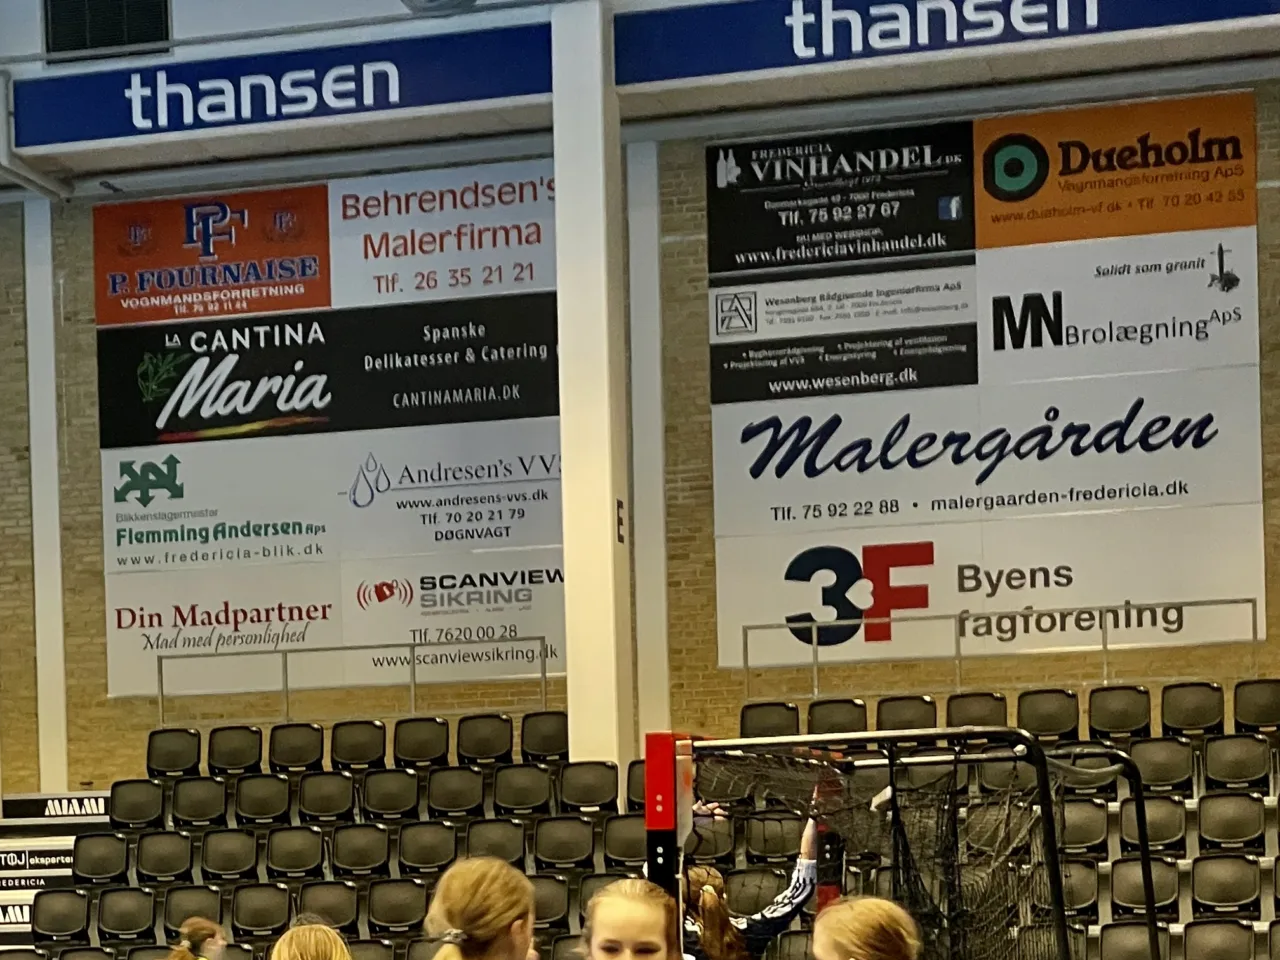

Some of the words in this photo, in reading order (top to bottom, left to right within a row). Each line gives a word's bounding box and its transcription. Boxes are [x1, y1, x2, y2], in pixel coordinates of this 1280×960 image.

[785, 0, 1099, 58] thansen
[124, 61, 400, 129] thansen
[751, 143, 833, 160] FREDERICIA
[1057, 127, 1244, 177] Dueholm
[363, 221, 543, 261] Malerfirma
[734, 232, 948, 265] www.fredericiavinhandel.dk
[136, 255, 320, 294] FOURNAISE
[373, 272, 404, 294] Tlf.
[414, 270, 438, 290] 26
[448, 267, 472, 287] 35
[482, 264, 503, 285] 21
[513, 262, 535, 282] 21
[1134, 262, 1162, 275] som
[120, 283, 306, 310] VOGNMANDSFORRETNING
[423, 321, 487, 344] Spanske
[992, 290, 1063, 351] MN
[1065, 316, 1209, 347] Brolægning
[1208, 306, 1243, 326] ApS
[165, 333, 182, 347] LA
[190, 321, 326, 353] CANTINA
[364, 351, 460, 372] Delikatesser
[465, 347, 476, 363] &
[481, 342, 548, 362] Catering
[155, 353, 332, 430] Maria
[393, 384, 521, 408] CANTINAMARIA.DK
[769, 368, 919, 395] www.wesenberg.dk
[740, 396, 1220, 487] Malergården
[396, 489, 549, 511] www.andresens-vvs.dk
[446, 512, 462, 524] 70
[466, 511, 483, 523] 20
[487, 509, 503, 521] 21
[508, 508, 526, 520] 79
[802, 502, 822, 520] 75
[827, 501, 849, 519] 92
[853, 500, 875, 518] 22
[879, 498, 901, 516] 88
[931, 480, 1190, 514] malergaarden-fredericia.dk
[116, 524, 210, 548] Flemming
[213, 520, 303, 541] Andersen
[434, 526, 512, 542] DØGNVAGT
[616, 498, 625, 545] E
[116, 543, 324, 567] www.fredericia-blik.dk
[420, 568, 564, 592] SCANVIEW
[784, 540, 935, 647] 3F
[957, 563, 1075, 599] Byens
[420, 588, 533, 609] SIKRING
[115, 606, 164, 630] Din
[172, 600, 333, 633] Madpartner
[958, 598, 1186, 644] fagforening
[141, 627, 183, 652] Mad
[182, 626, 217, 648] med
[215, 621, 311, 654] personlighed
[435, 627, 473, 643] 7620
[476, 626, 496, 641] 00
[500, 624, 518, 639] 28
[45, 797, 105, 816] MIAMI
